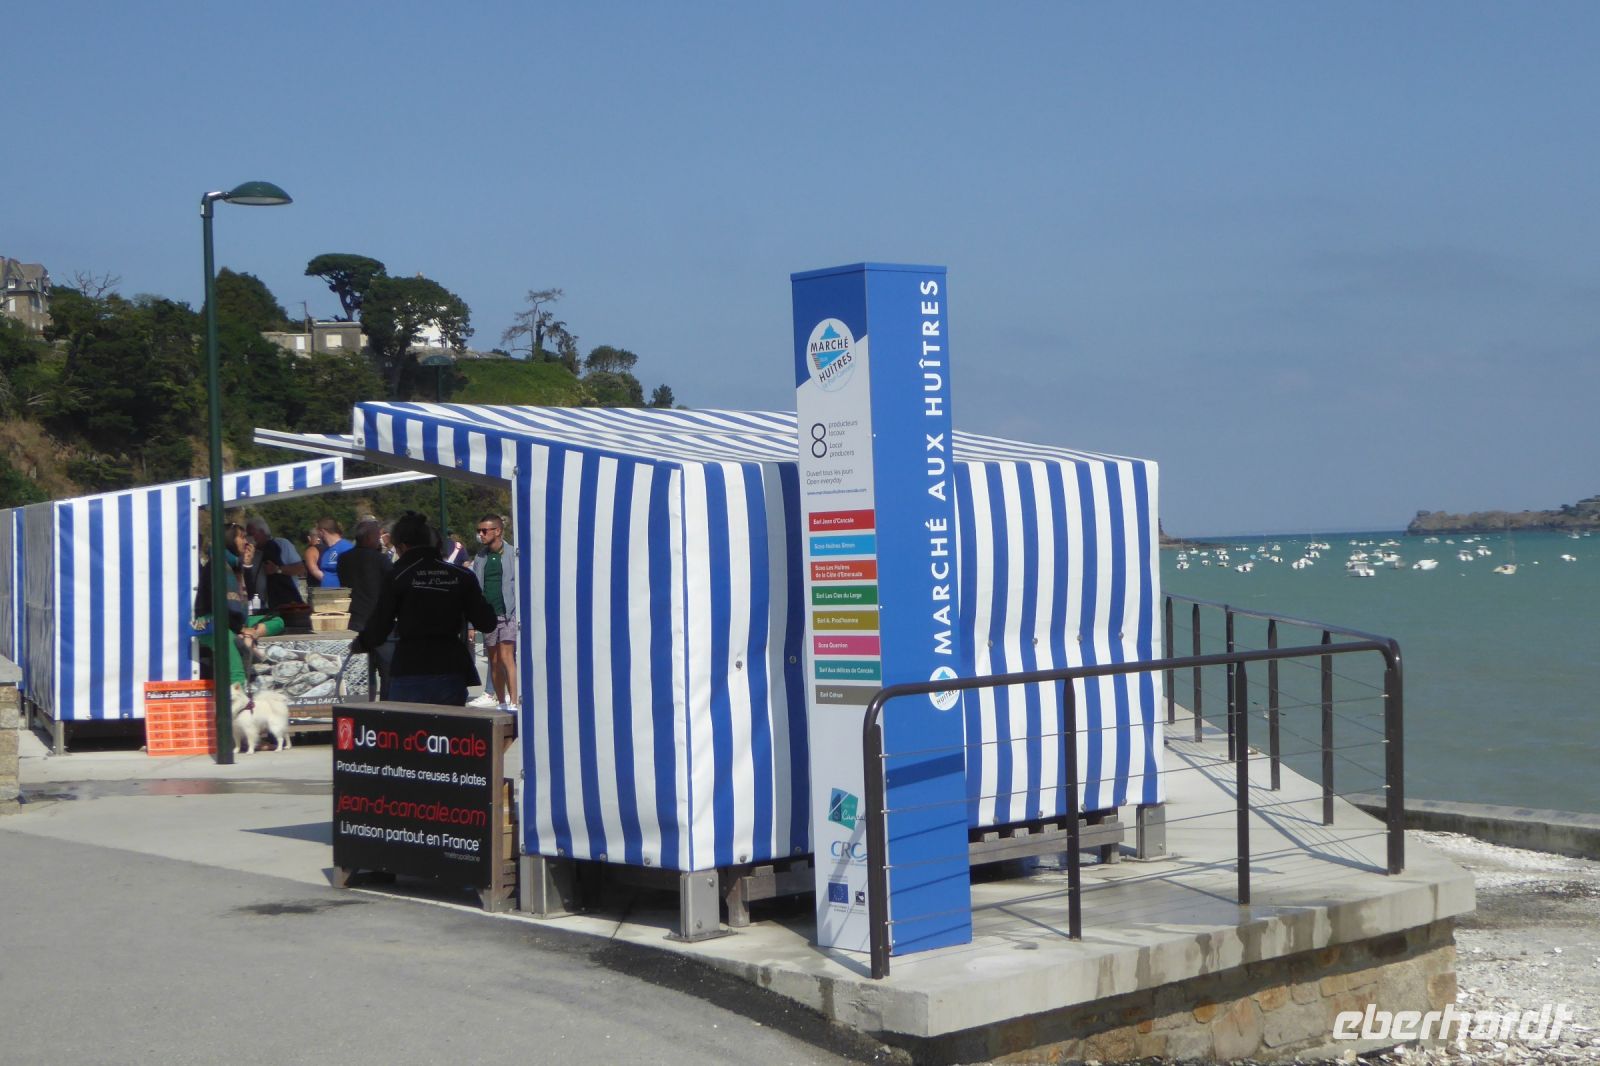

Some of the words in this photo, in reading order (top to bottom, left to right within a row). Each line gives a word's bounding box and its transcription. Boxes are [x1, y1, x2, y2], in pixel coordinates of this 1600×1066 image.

[810, 336, 849, 353] MARCHÉ
[918, 280, 943, 416] HUÎTRES
[828, 420, 858, 429] producteurs
[811, 422, 827, 458] 8
[829, 450, 855, 459] producers
[926, 433, 946, 501] AUX
[925, 518, 952, 655] MARCHÉ
[354, 725, 399, 750] Jean
[336, 760, 380, 775] Producteur
[381, 765, 416, 779] d'huîtres
[417, 770, 450, 782] creuses
[452, 772, 459, 783] &
[460, 773, 487, 786] plates
[336, 794, 487, 827] jean-d-cancale.com
[340, 820, 384, 839] Livraison
[386, 828, 425, 845] partout
[427, 834, 440, 847] en
[442, 834, 480, 851] France
[830, 840, 867, 861] CRC
